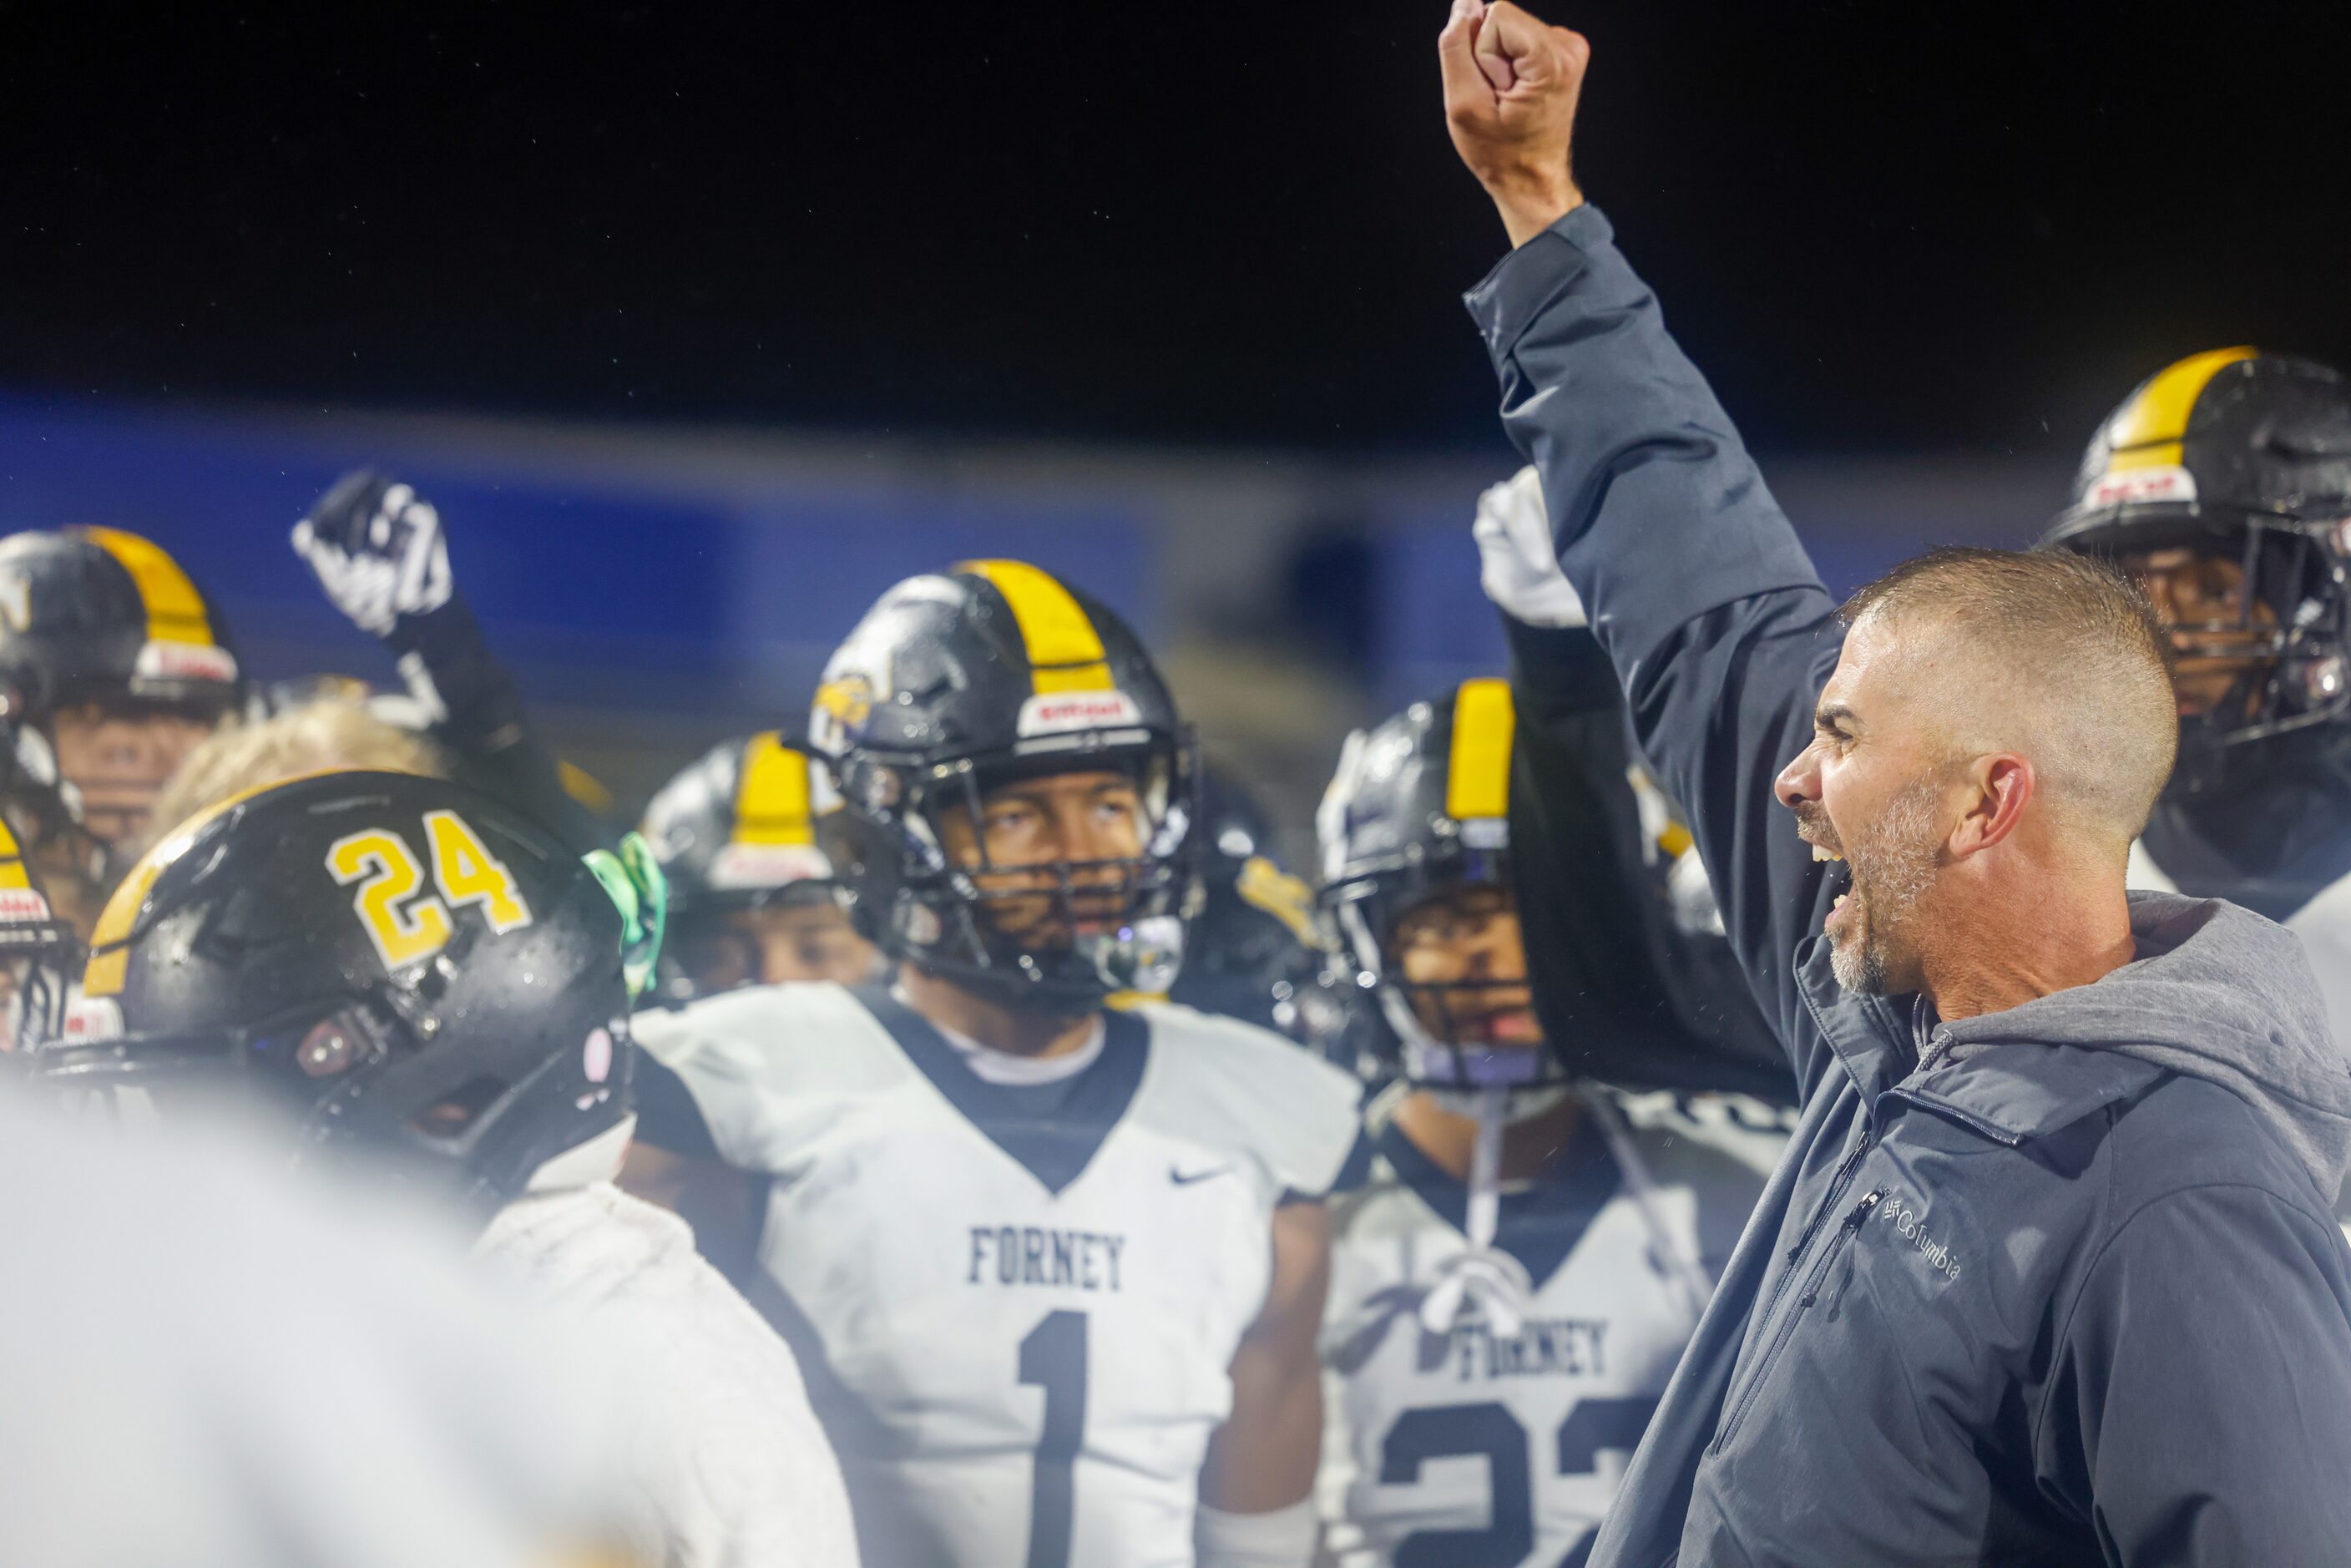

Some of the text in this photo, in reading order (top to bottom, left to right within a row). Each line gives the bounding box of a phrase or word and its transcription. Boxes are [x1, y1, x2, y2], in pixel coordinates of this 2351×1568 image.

[325, 809, 533, 972] 24
[968, 1226, 1126, 1292] FORNEY
[1897, 1210, 1961, 1280] Columbia
[1019, 1309, 1089, 1568] 1
